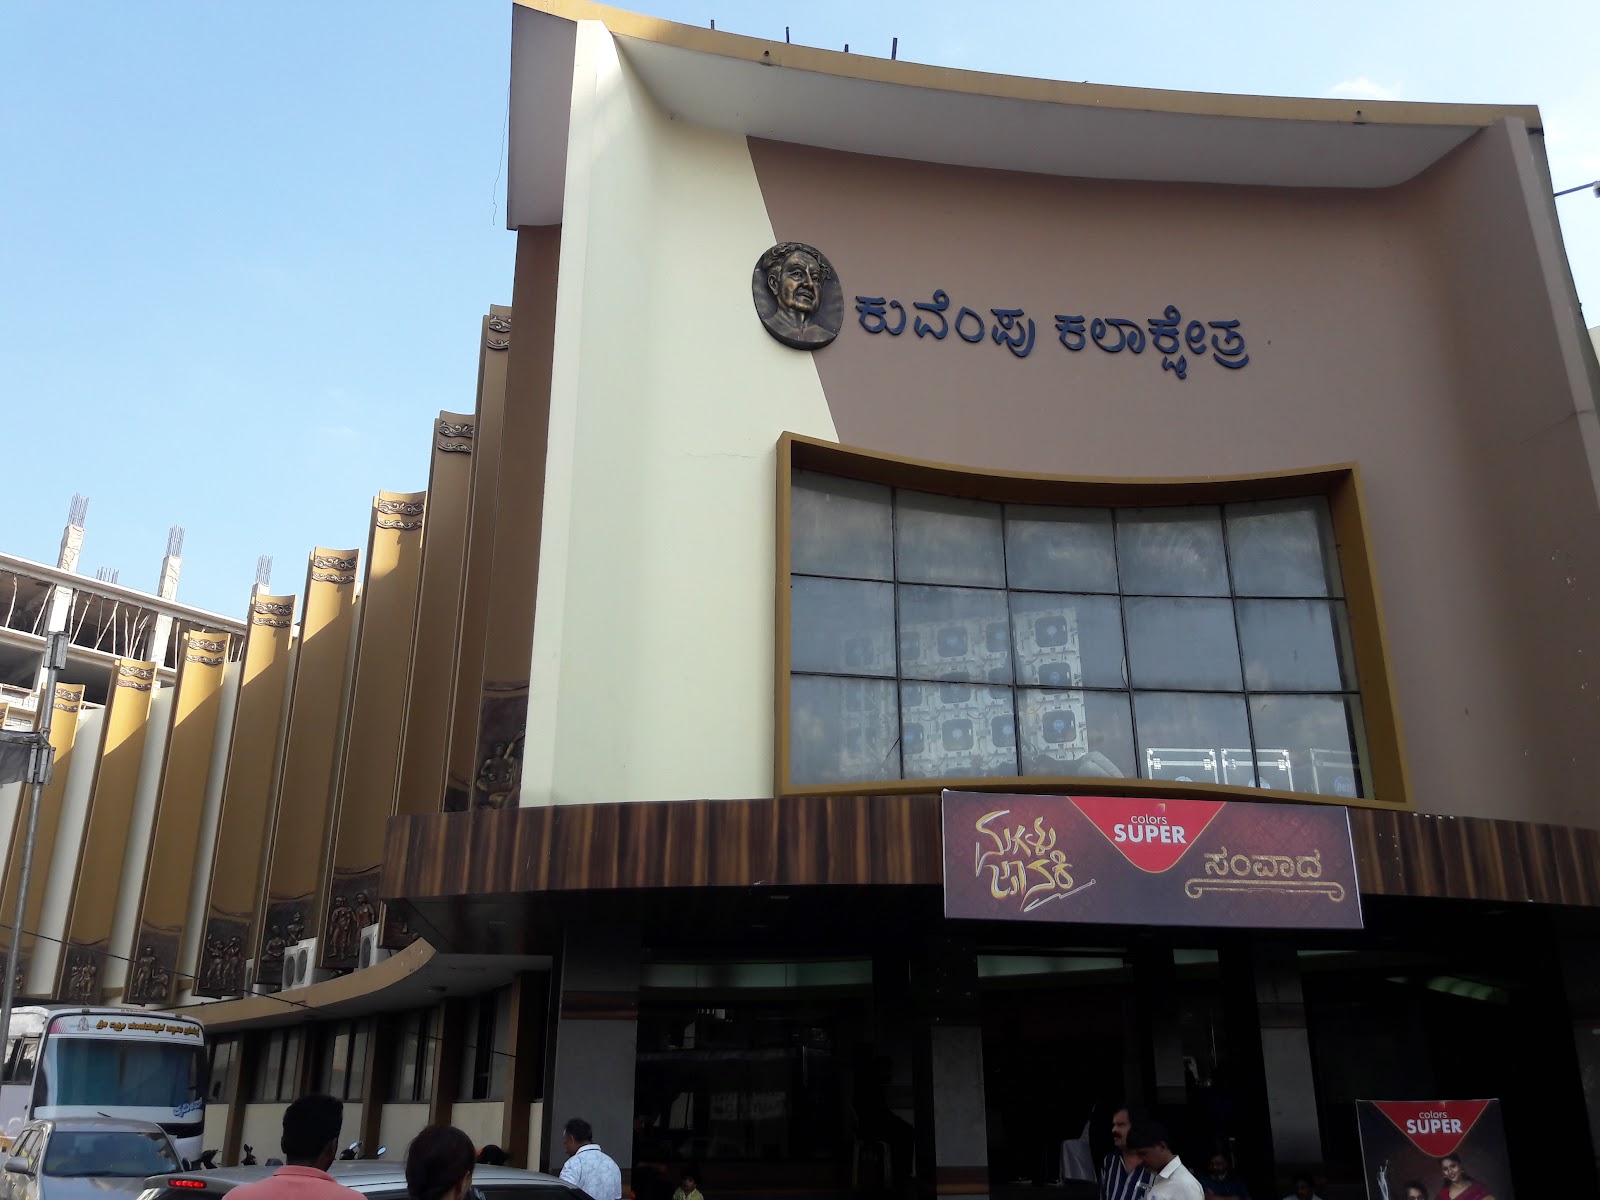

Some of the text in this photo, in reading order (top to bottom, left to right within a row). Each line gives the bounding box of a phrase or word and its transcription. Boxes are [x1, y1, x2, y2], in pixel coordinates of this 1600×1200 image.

[855, 288, 1250, 380] ಕುವೆಂಪು ಕಲಾಕ್ಷೇತ್ರ
[1130, 813, 1168, 825] colors
[1113, 823, 1187, 844] SUPER
[1203, 846, 1322, 878] ಸಂವಾದ
[1419, 1111, 1447, 1119] colors
[1407, 1119, 1463, 1134] SUPER
